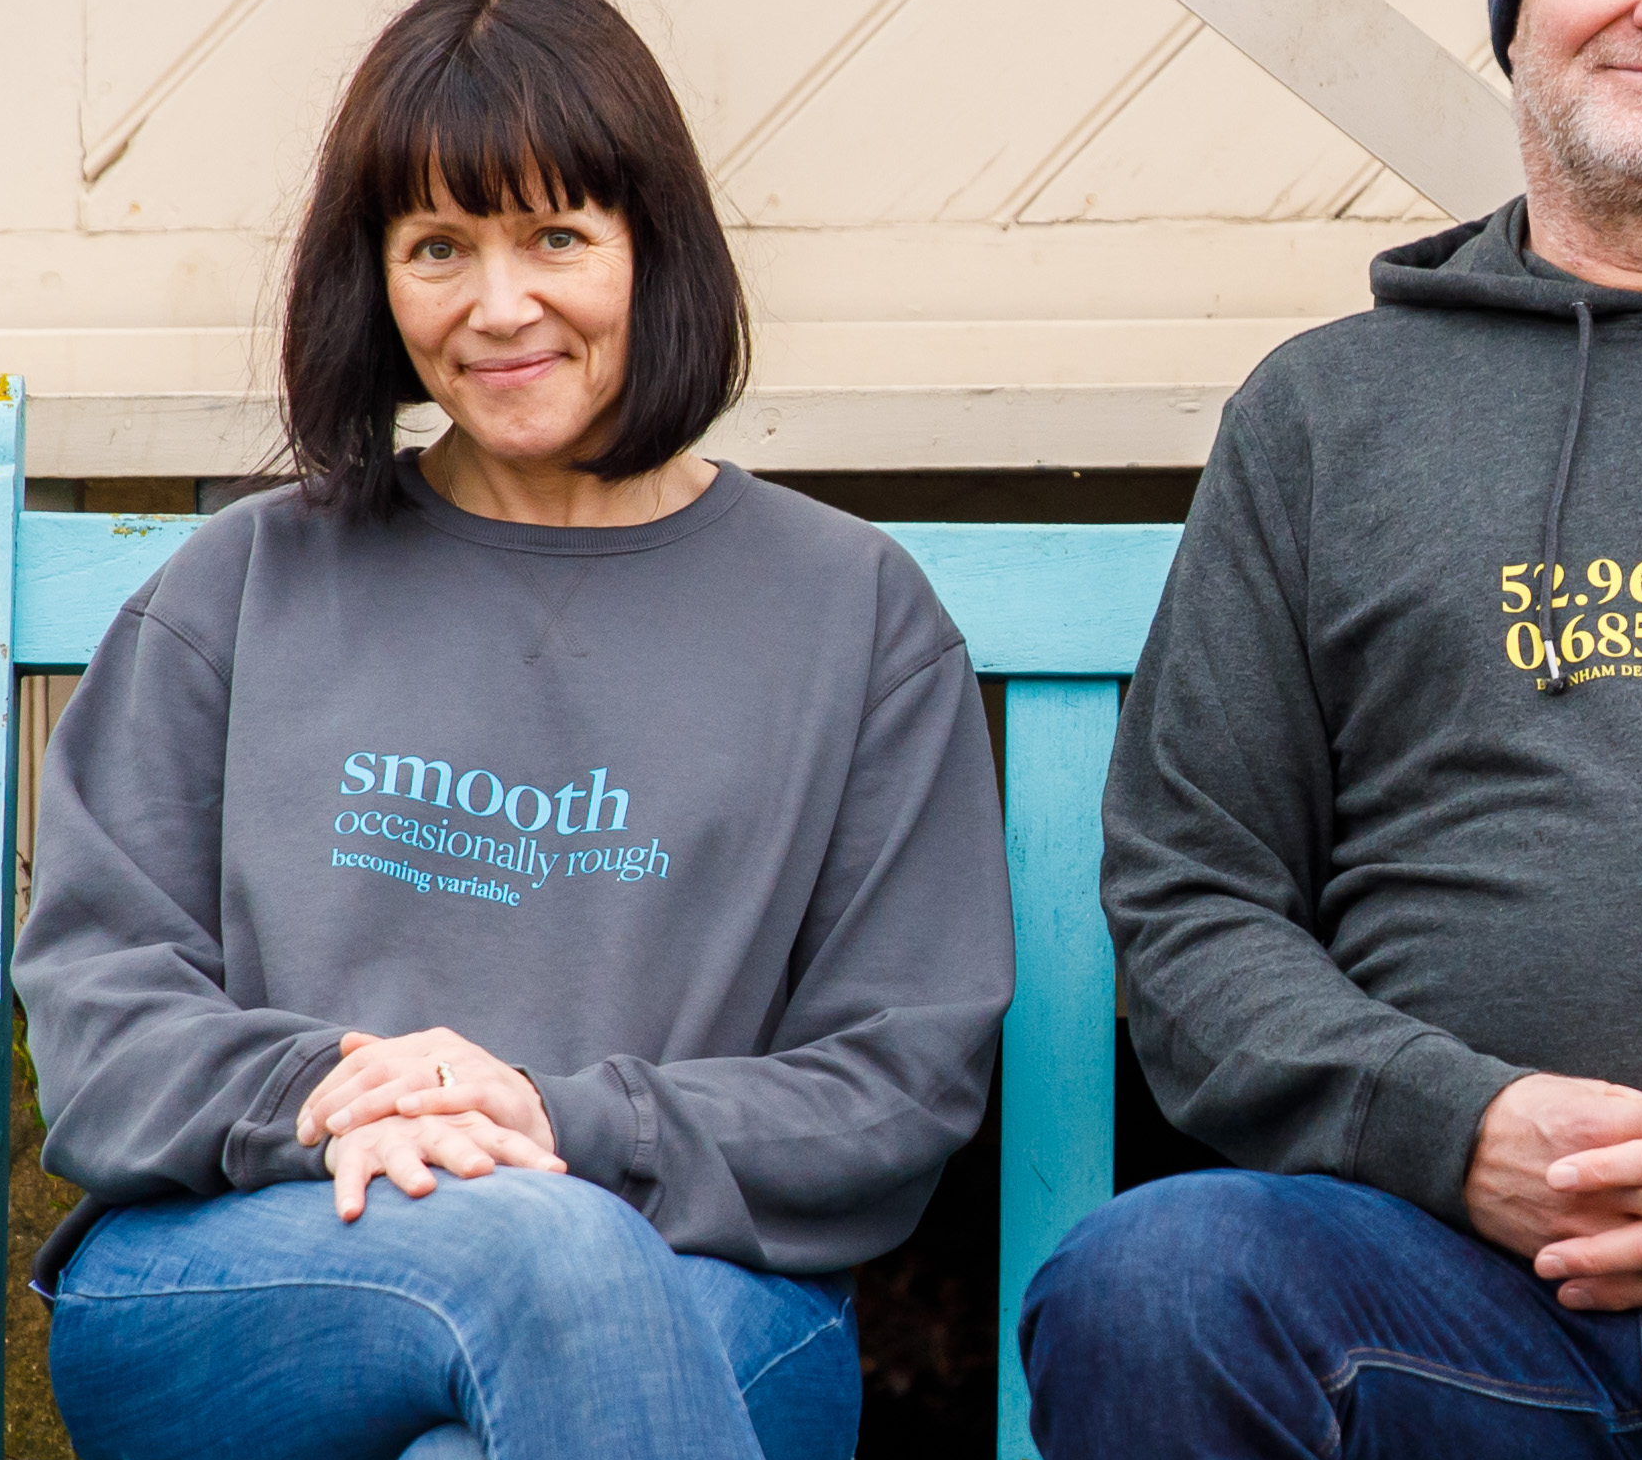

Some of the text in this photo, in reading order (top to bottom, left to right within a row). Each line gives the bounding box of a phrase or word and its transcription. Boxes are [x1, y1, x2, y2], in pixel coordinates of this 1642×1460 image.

[1536, 664, 1615, 690] BNHAM
[340, 751, 629, 835] smooth
[331, 848, 522, 907] becoming variable
[334, 810, 671, 889] occasionally rough
